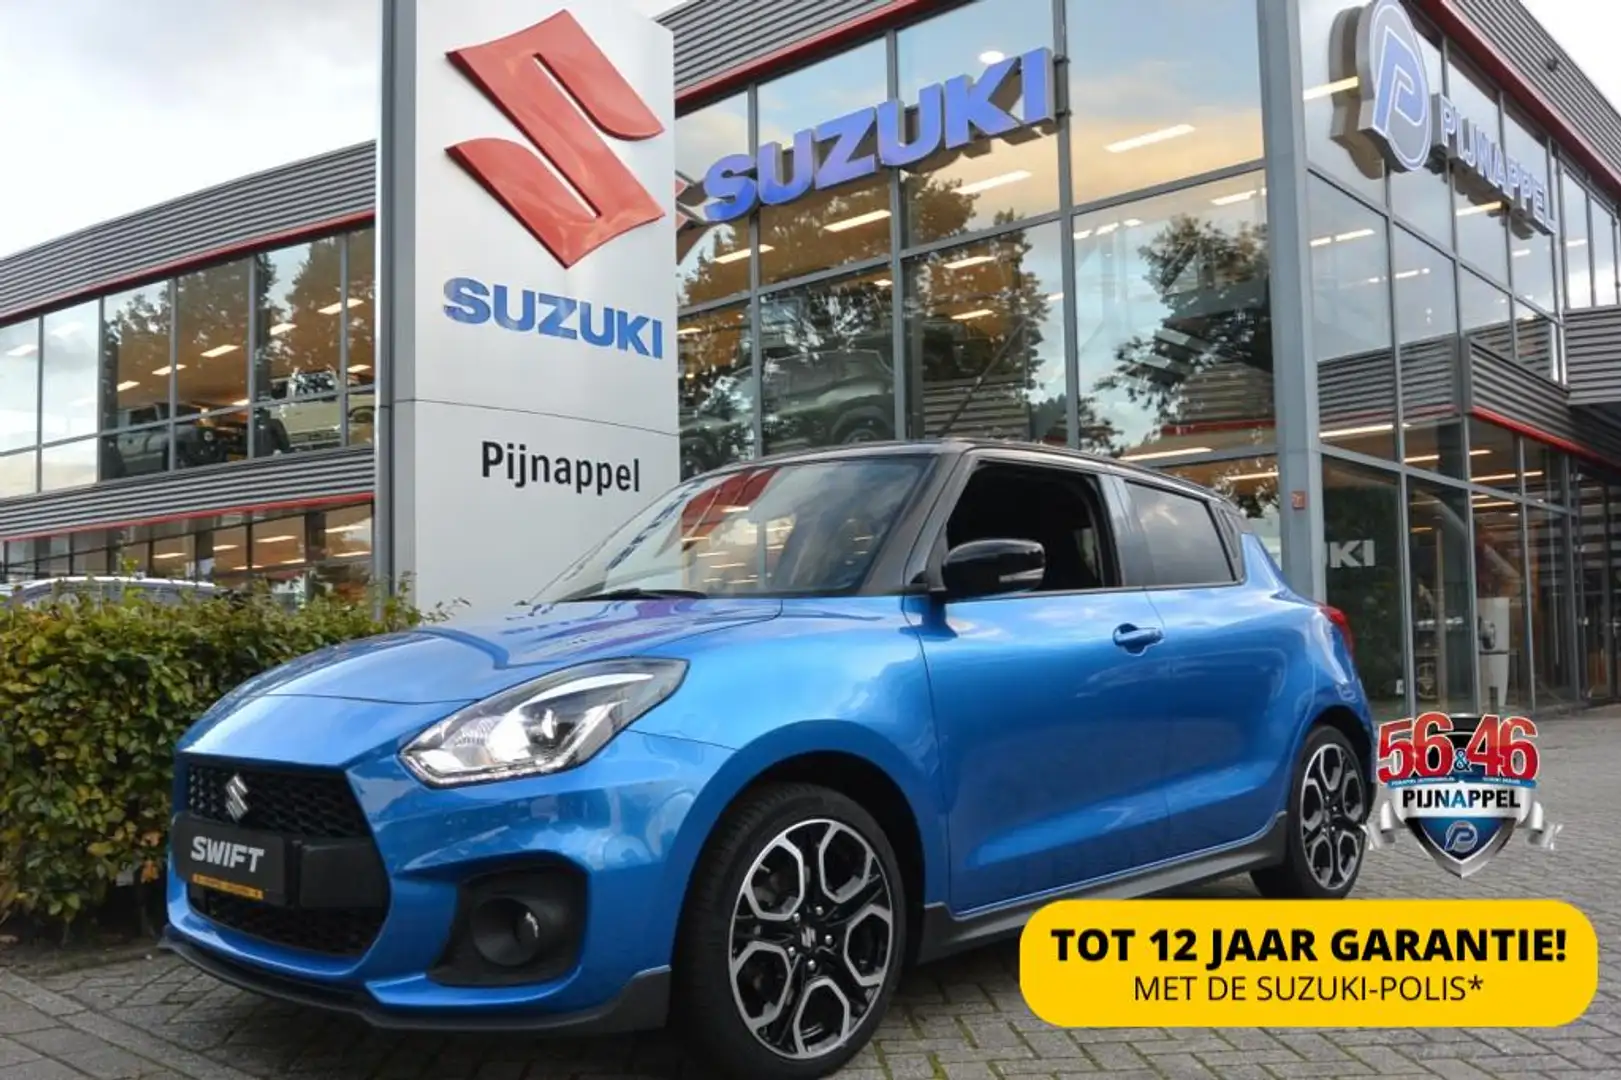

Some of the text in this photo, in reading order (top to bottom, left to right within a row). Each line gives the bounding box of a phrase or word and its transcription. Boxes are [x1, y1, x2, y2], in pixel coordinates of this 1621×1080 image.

[703, 47, 1054, 223] SUZUKI
[1440, 95, 1556, 235] PIJNAPPEL
[443, 277, 663, 359] SUZUKI
[481, 441, 640, 497] Pijnappel
[1326, 539, 1375, 568] KI
[190, 836, 265, 873] SWIFT
